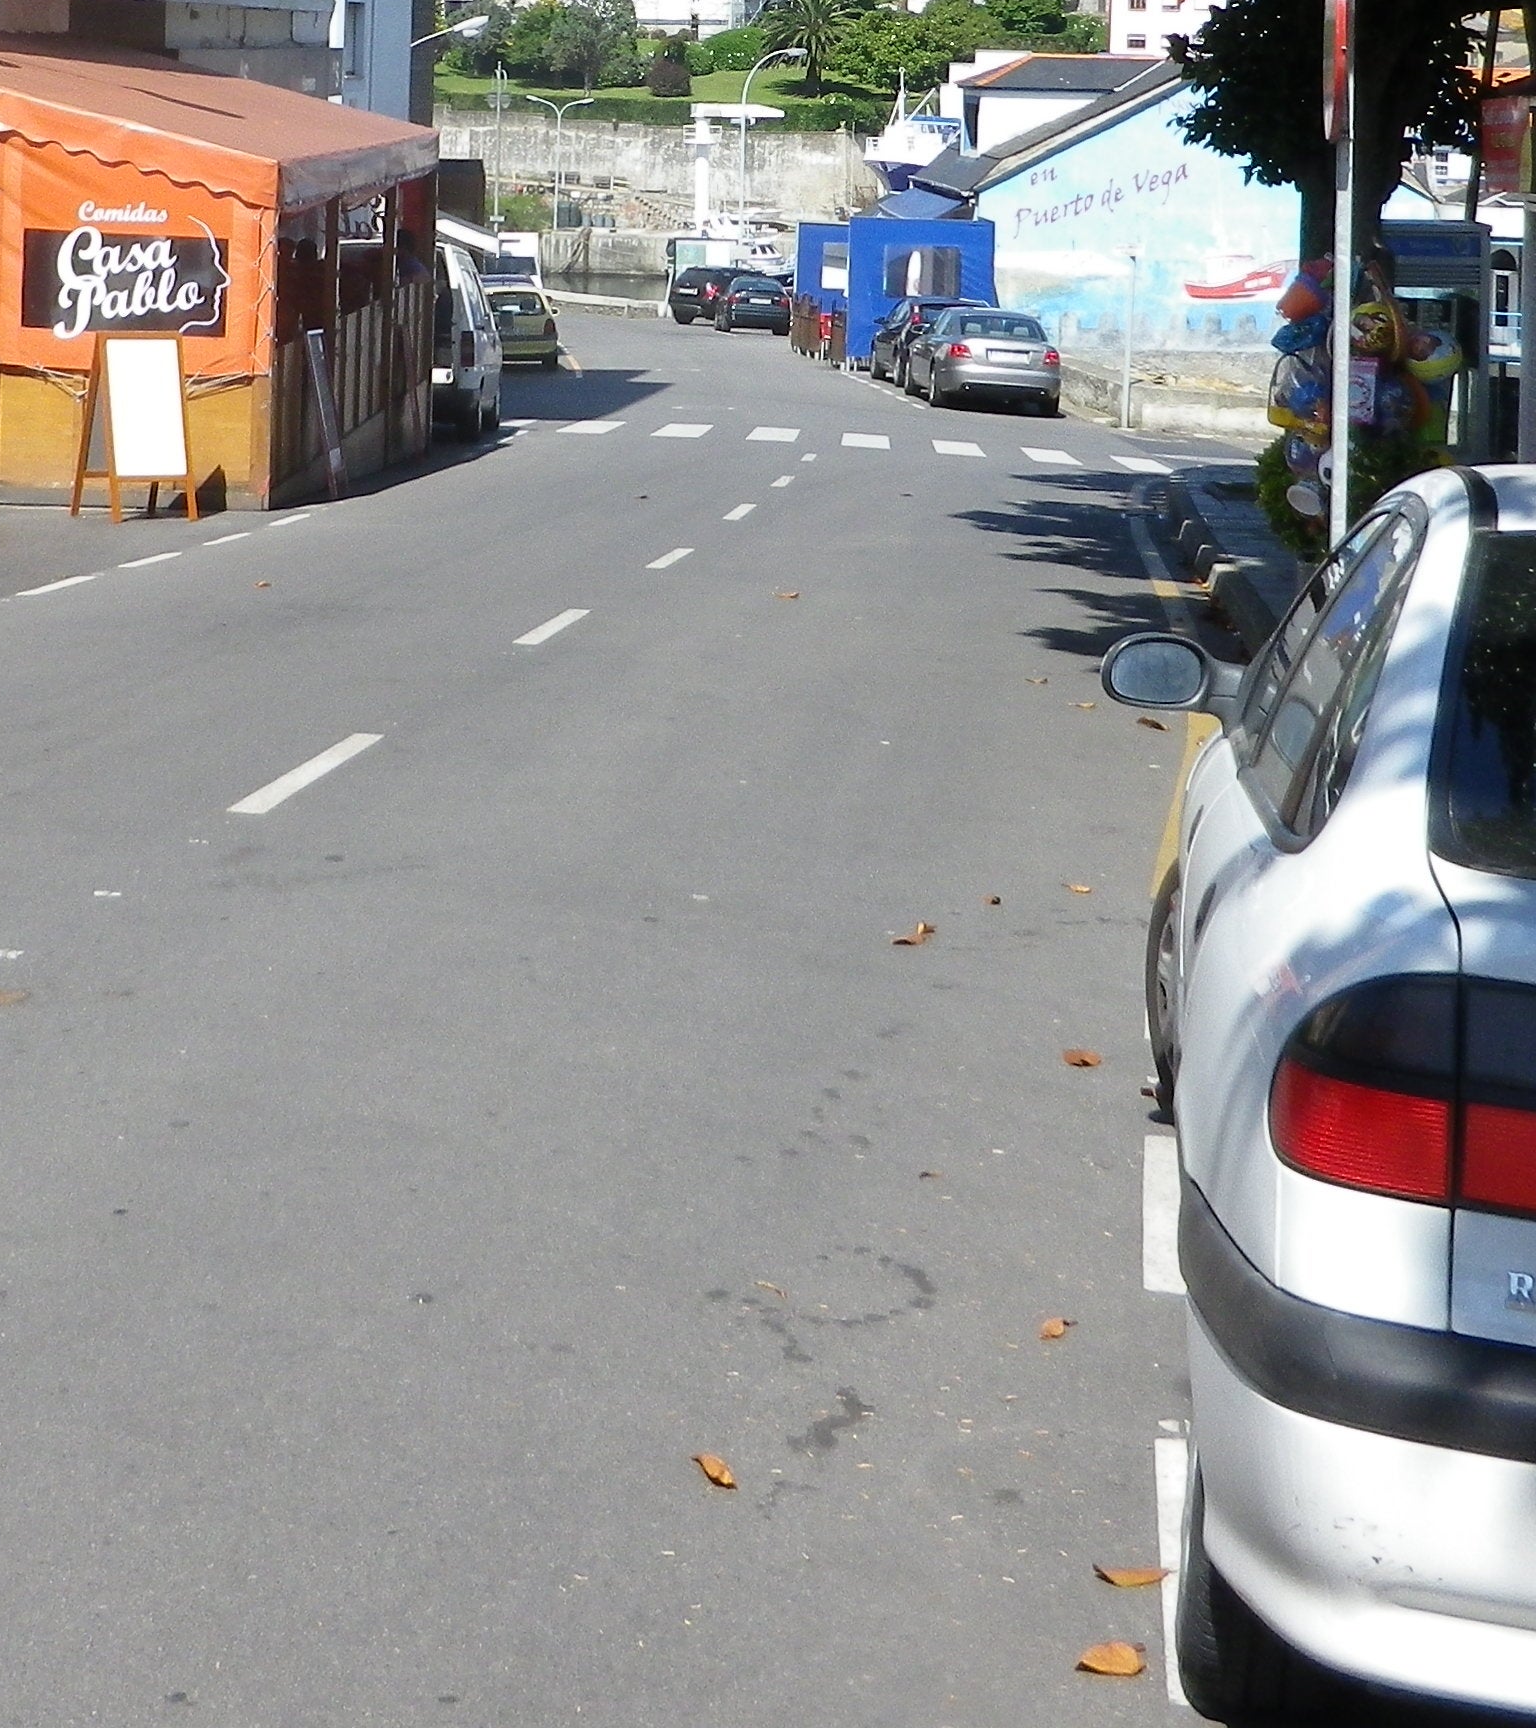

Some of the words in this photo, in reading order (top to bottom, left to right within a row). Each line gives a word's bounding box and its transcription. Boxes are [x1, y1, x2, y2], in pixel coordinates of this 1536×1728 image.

[1013, 193, 1094, 239] Puerto
[1101, 179, 1124, 213] de
[1132, 162, 1189, 205] Vega
[1030, 166, 1058, 186] en
[78, 200, 168, 222] Comidas
[57, 225, 178, 283] Casa
[53, 268, 205, 339] Pablo
